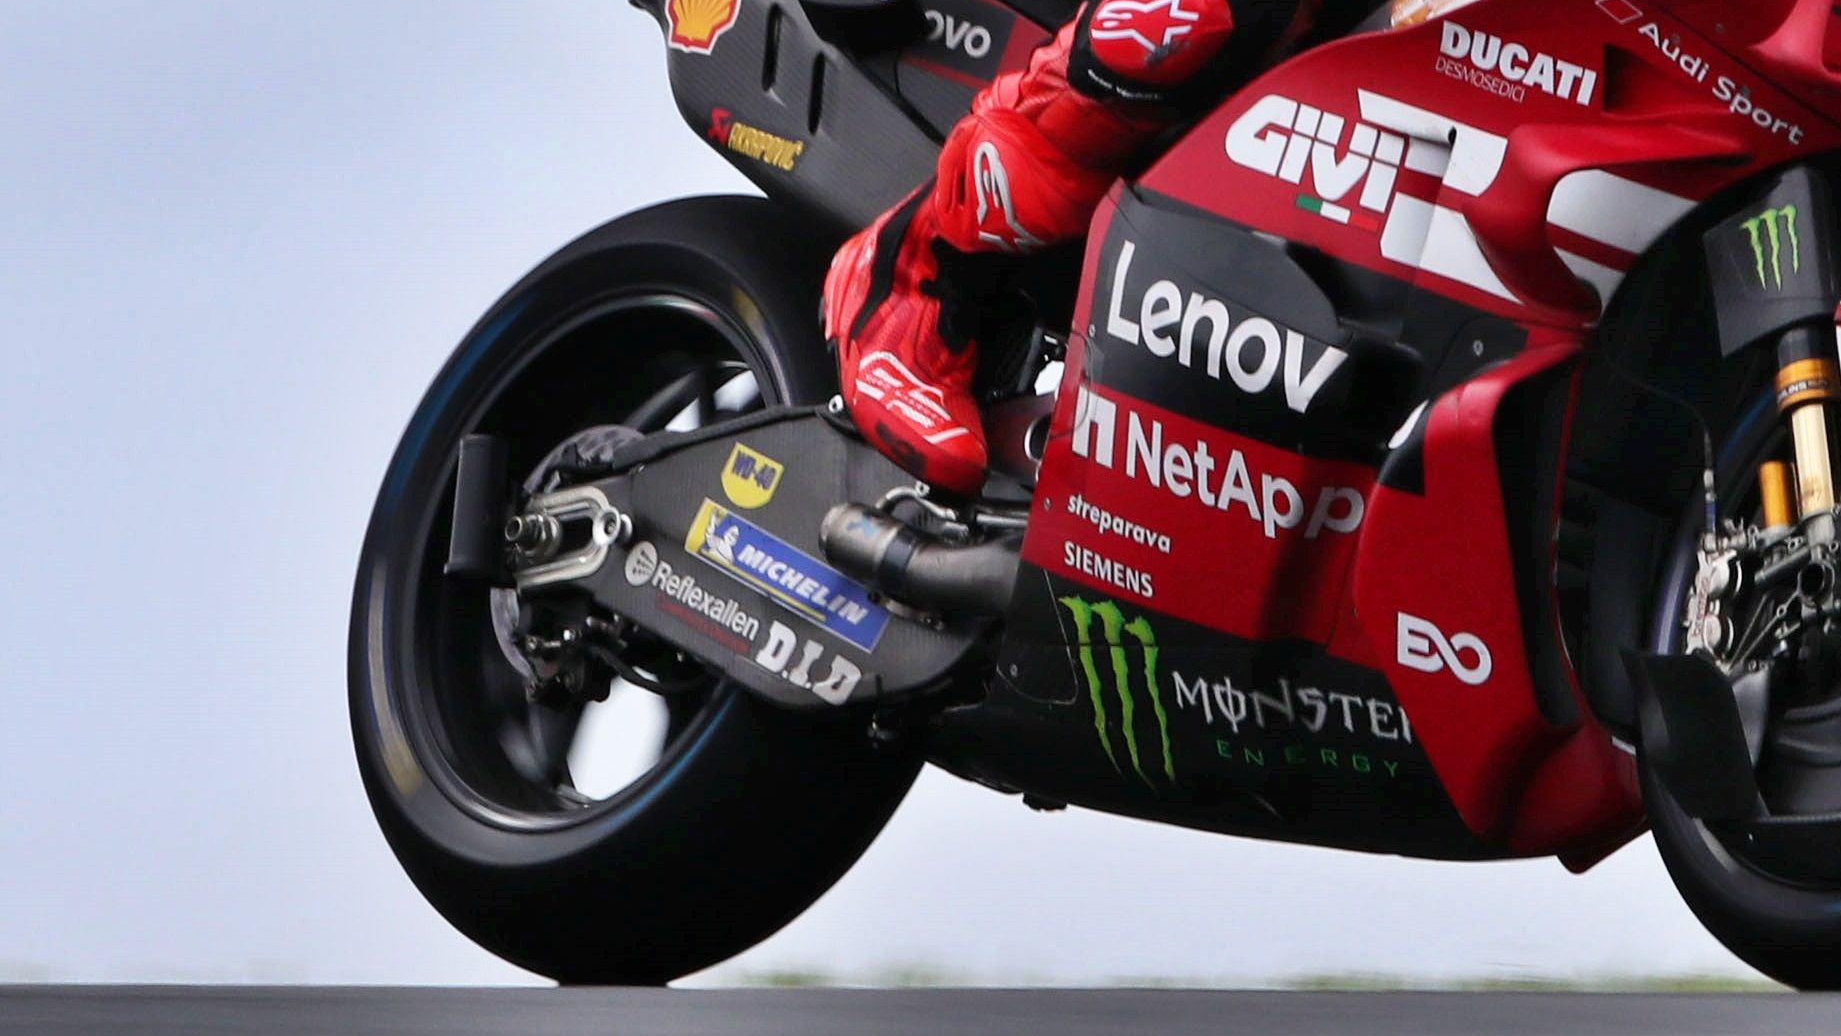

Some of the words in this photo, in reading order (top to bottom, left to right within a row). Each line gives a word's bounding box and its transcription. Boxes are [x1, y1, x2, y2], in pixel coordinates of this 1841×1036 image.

[1434, 56, 1525, 104] DESMOSEDICI
[1440, 19, 1598, 107] DUCATI
[1638, 21, 1711, 83] Audi
[1711, 74, 1805, 146] Sport
[1224, 93, 1408, 214] GIVI
[1106, 239, 1350, 415] Lenov
[730, 454, 777, 492] WD-40
[1125, 410, 1365, 541] NetApp
[1066, 492, 1172, 555] streparava
[650, 560, 761, 642] Reflexallen
[736, 543, 871, 627] MICHELIN
[1063, 540, 1154, 599] SIEMENS
[1215, 738, 1400, 779] ENERGY
